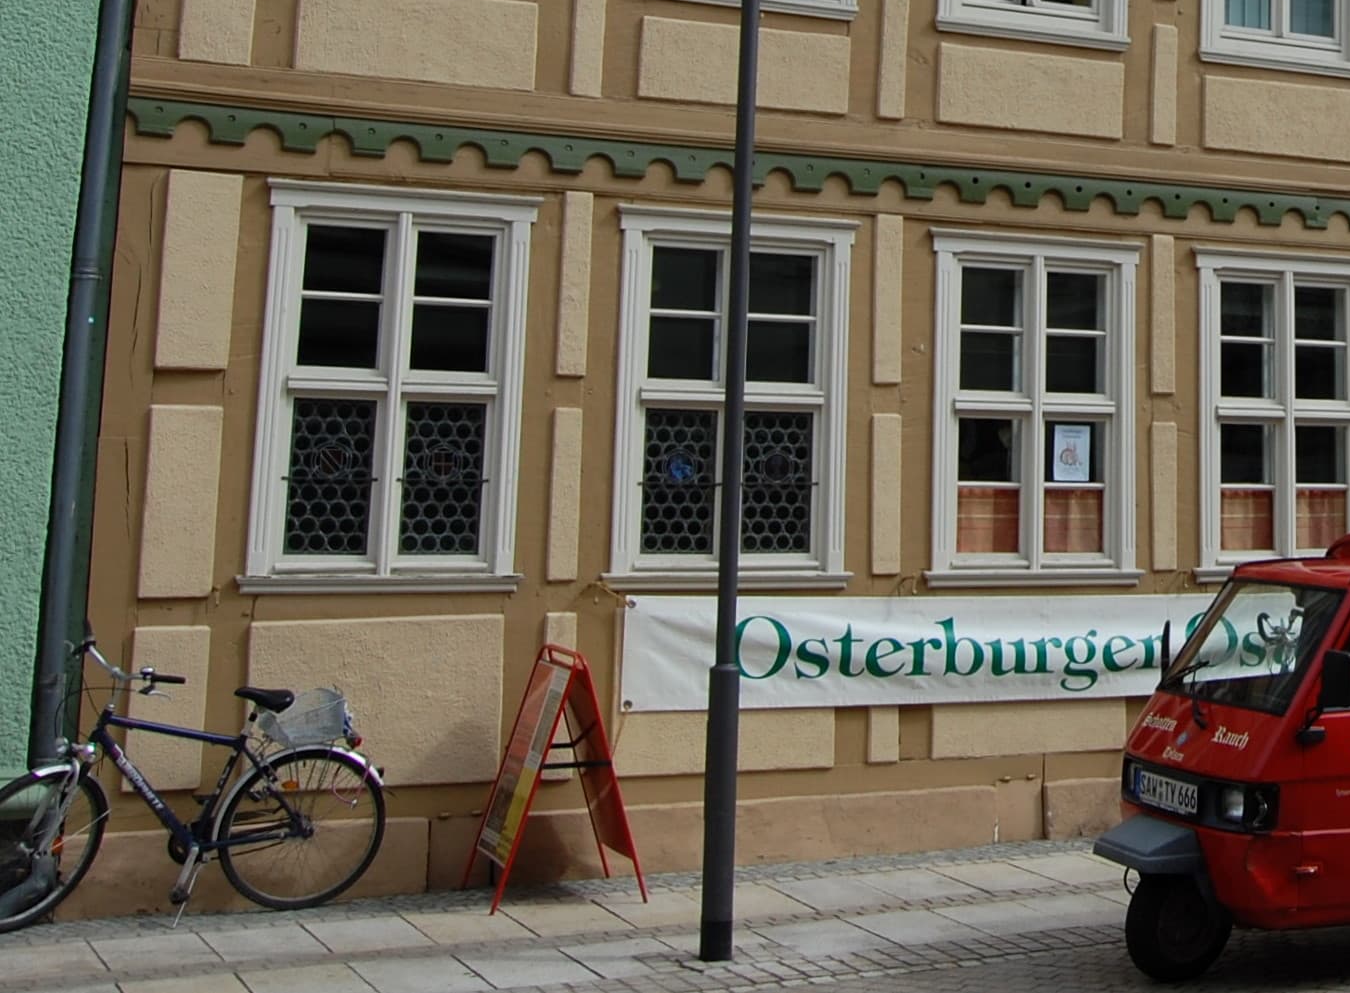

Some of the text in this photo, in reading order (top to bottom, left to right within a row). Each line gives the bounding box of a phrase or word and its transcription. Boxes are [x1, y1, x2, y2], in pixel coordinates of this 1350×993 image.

[735, 615, 1163, 692] Osterburger
[1211, 725, 1250, 750] Rauch
[1178, 785, 1197, 809] 666
